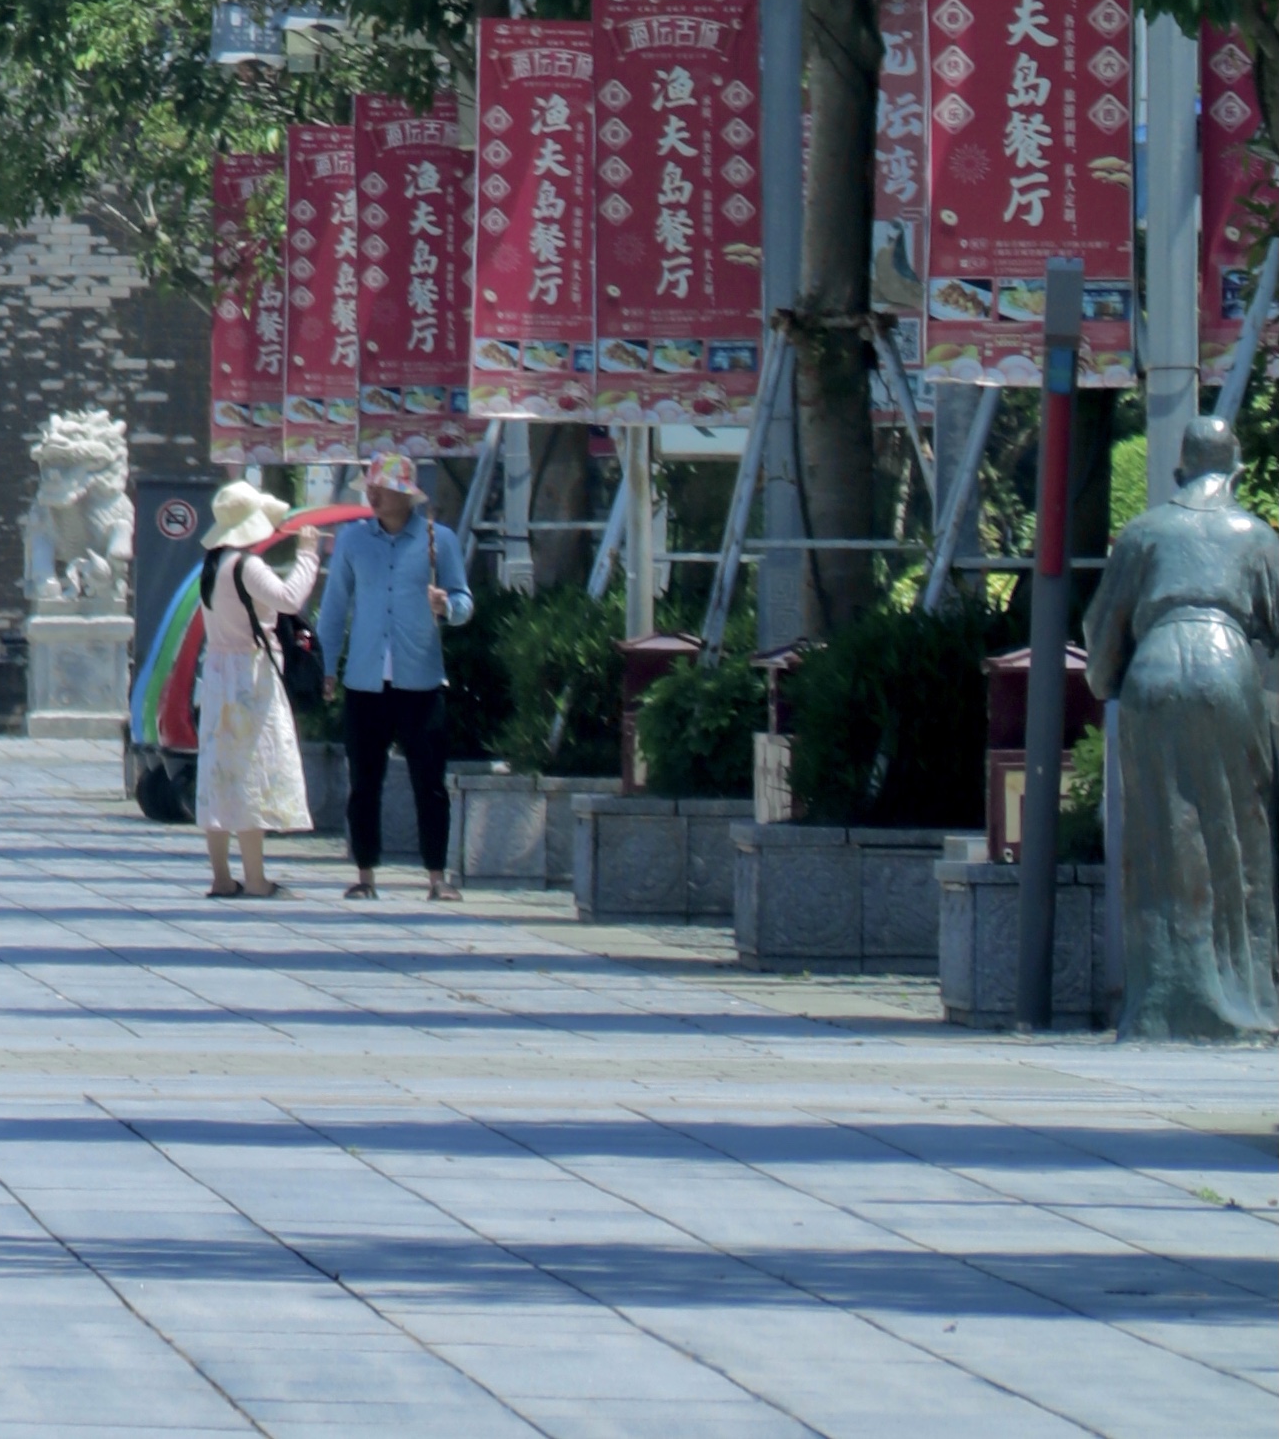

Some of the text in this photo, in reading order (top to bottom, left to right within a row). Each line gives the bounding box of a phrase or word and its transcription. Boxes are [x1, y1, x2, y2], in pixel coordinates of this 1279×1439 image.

[404, 160, 443, 352] 渔夫岛餐厅
[529, 93, 572, 305] 渔夫岛餐厅
[650, 65, 699, 299] 渔夫岛餐厅
